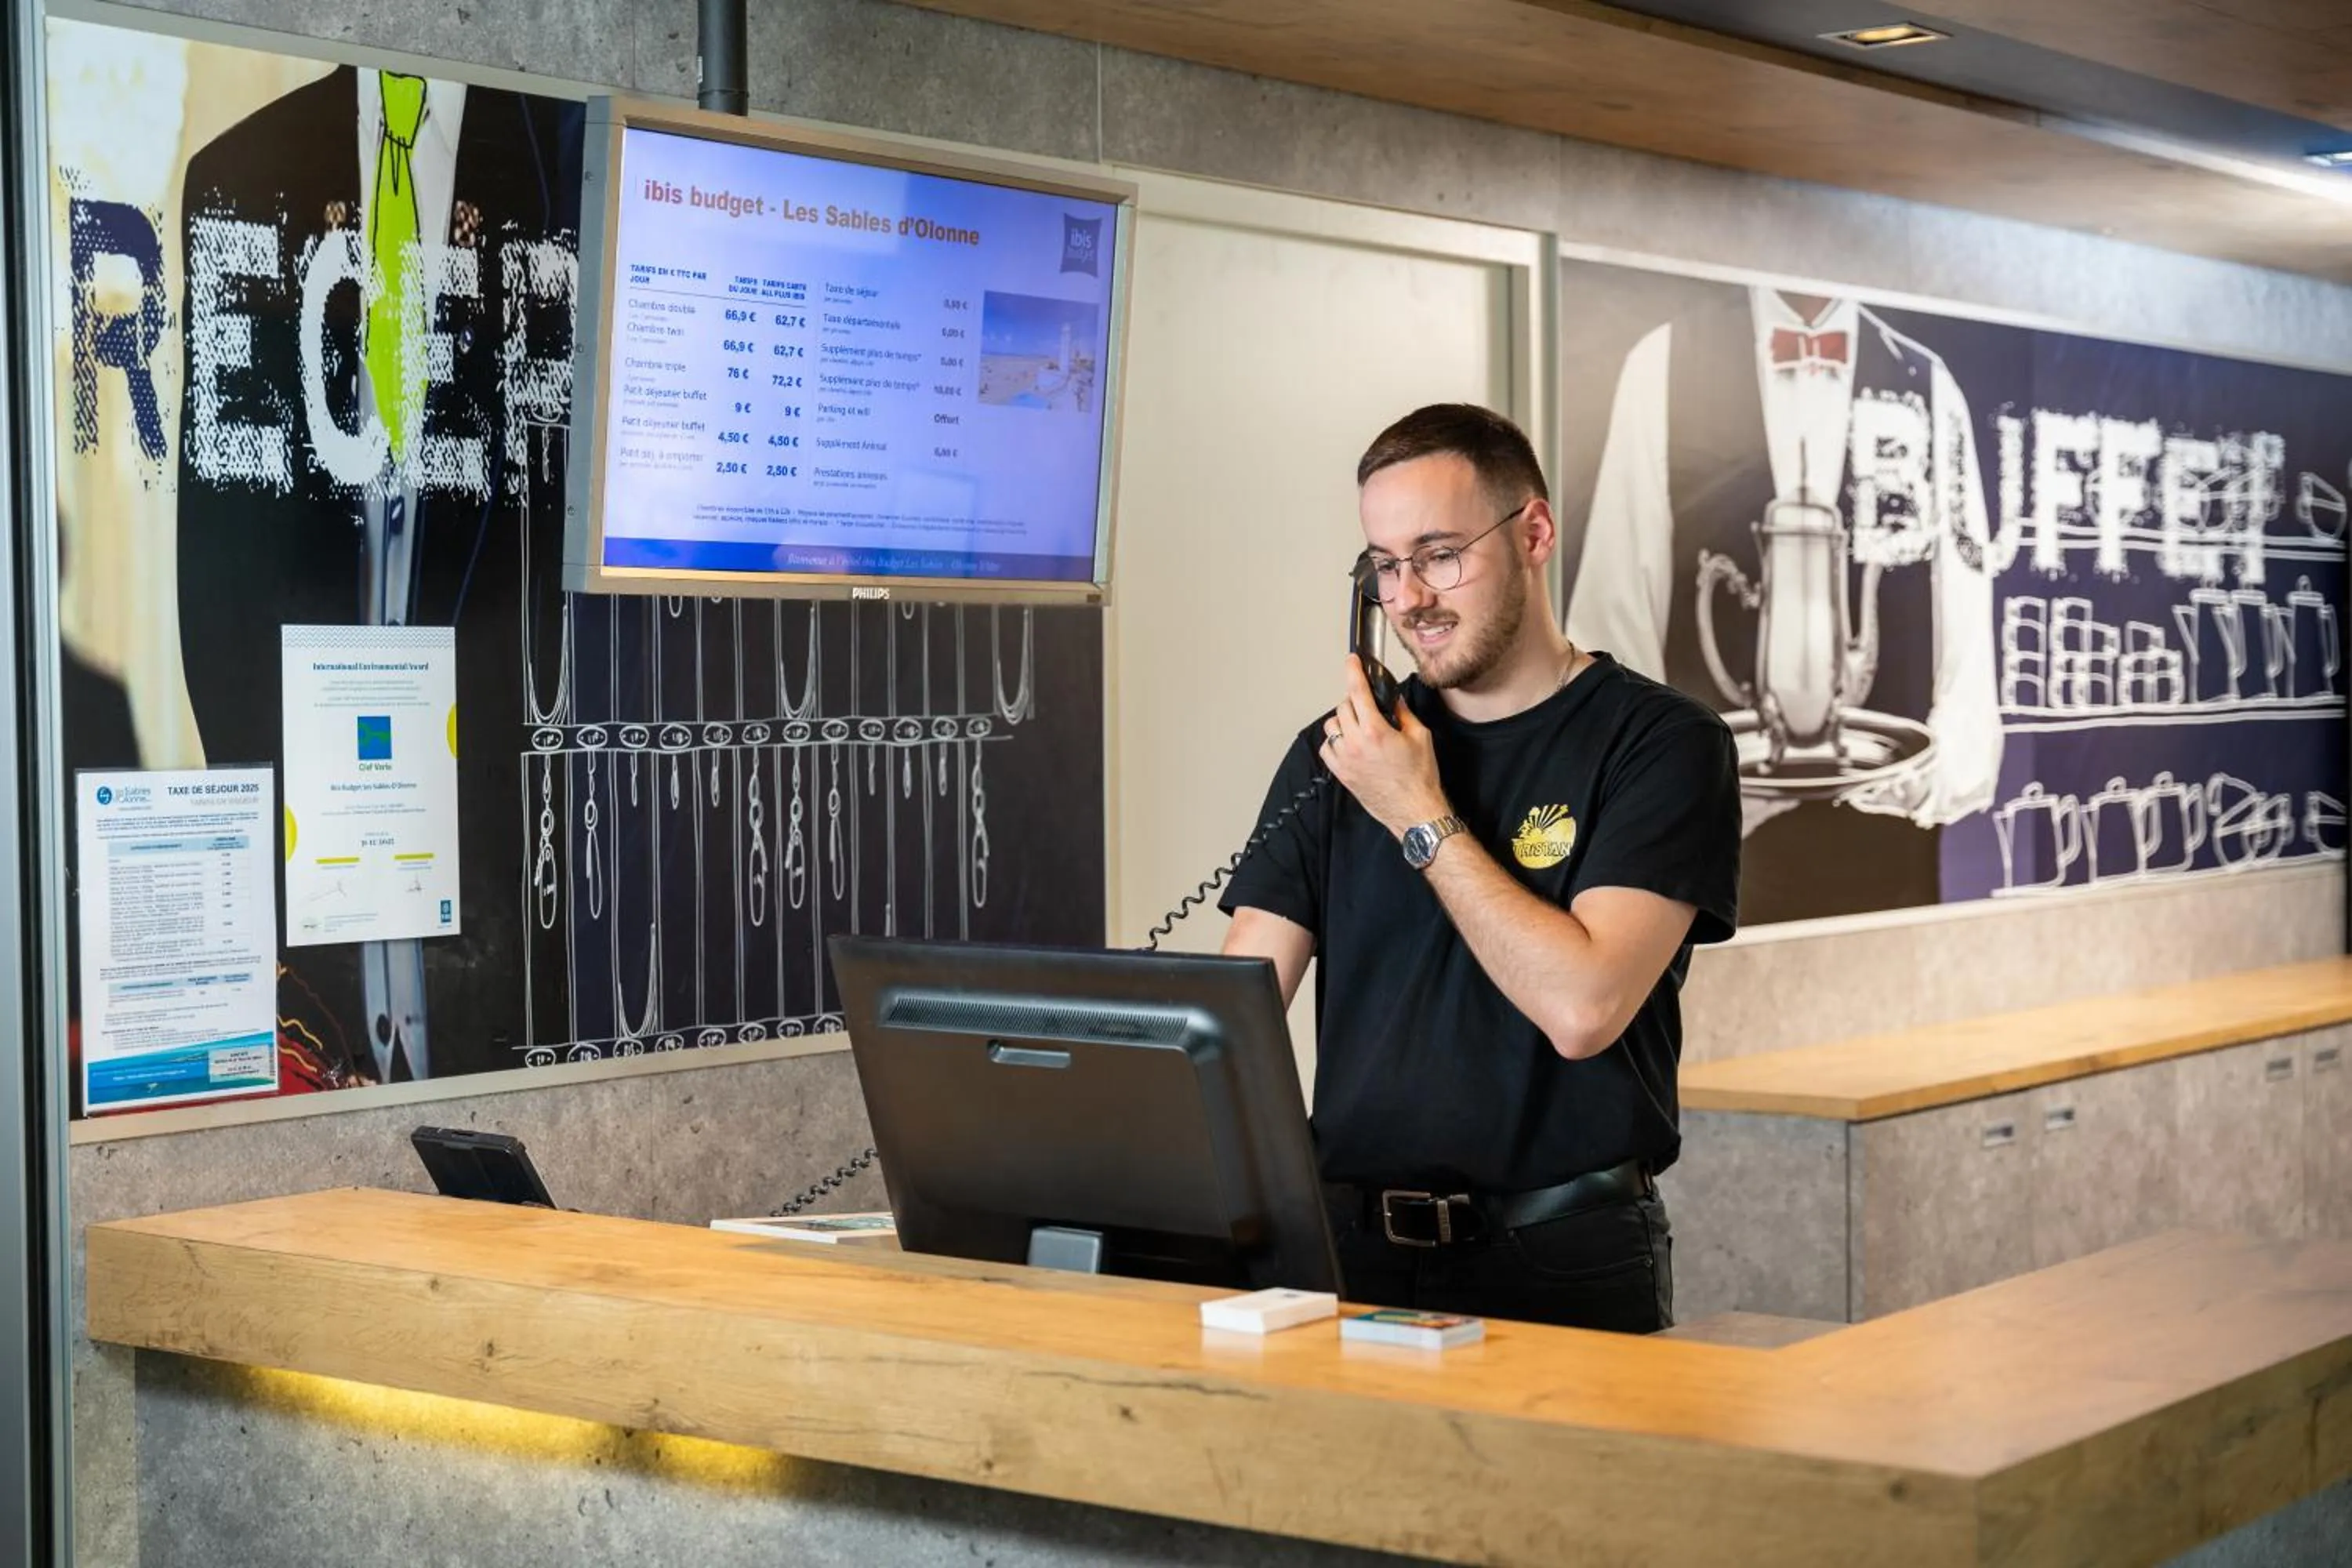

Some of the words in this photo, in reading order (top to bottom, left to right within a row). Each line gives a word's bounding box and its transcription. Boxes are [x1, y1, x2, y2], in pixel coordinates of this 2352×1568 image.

[644, 180, 683, 204] ibis
[691, 185, 764, 218] budget
[783, 199, 818, 223] Les
[826, 205, 892, 234] Sables
[898, 216, 979, 246] d'Olonne
[1071, 228, 1091, 249] ibis
[630, 264, 656, 274] TARIFS
[725, 309, 747, 322] 66,9
[749, 311, 757, 322] €
[775, 314, 797, 326] 62,7
[799, 317, 807, 328] €
[724, 339, 746, 353] 66,9
[747, 342, 754, 354] €
[774, 345, 795, 358] 62,7
[797, 347, 804, 358] €
[728, 367, 740, 379] 76
[742, 368, 749, 379] €
[771, 374, 793, 387] 72,2
[796, 377, 803, 388] €
[683, 388, 708, 400] buffet
[735, 402, 742, 412] 9
[744, 402, 751, 413] €
[794, 407, 800, 417] €
[717, 431, 740, 445] 4,50
[742, 433, 750, 444] €
[768, 434, 789, 448] 4,50
[792, 437, 799, 448] €
[716, 462, 739, 474] 2,50
[741, 463, 747, 474] €
[766, 465, 788, 477] 2,50
[790, 466, 797, 477] €
[1847, 388, 2285, 585] BUFFET
[852, 586, 891, 600] PHILIPS
[167, 786, 189, 796] TAXE
[192, 785, 203, 794] DE
